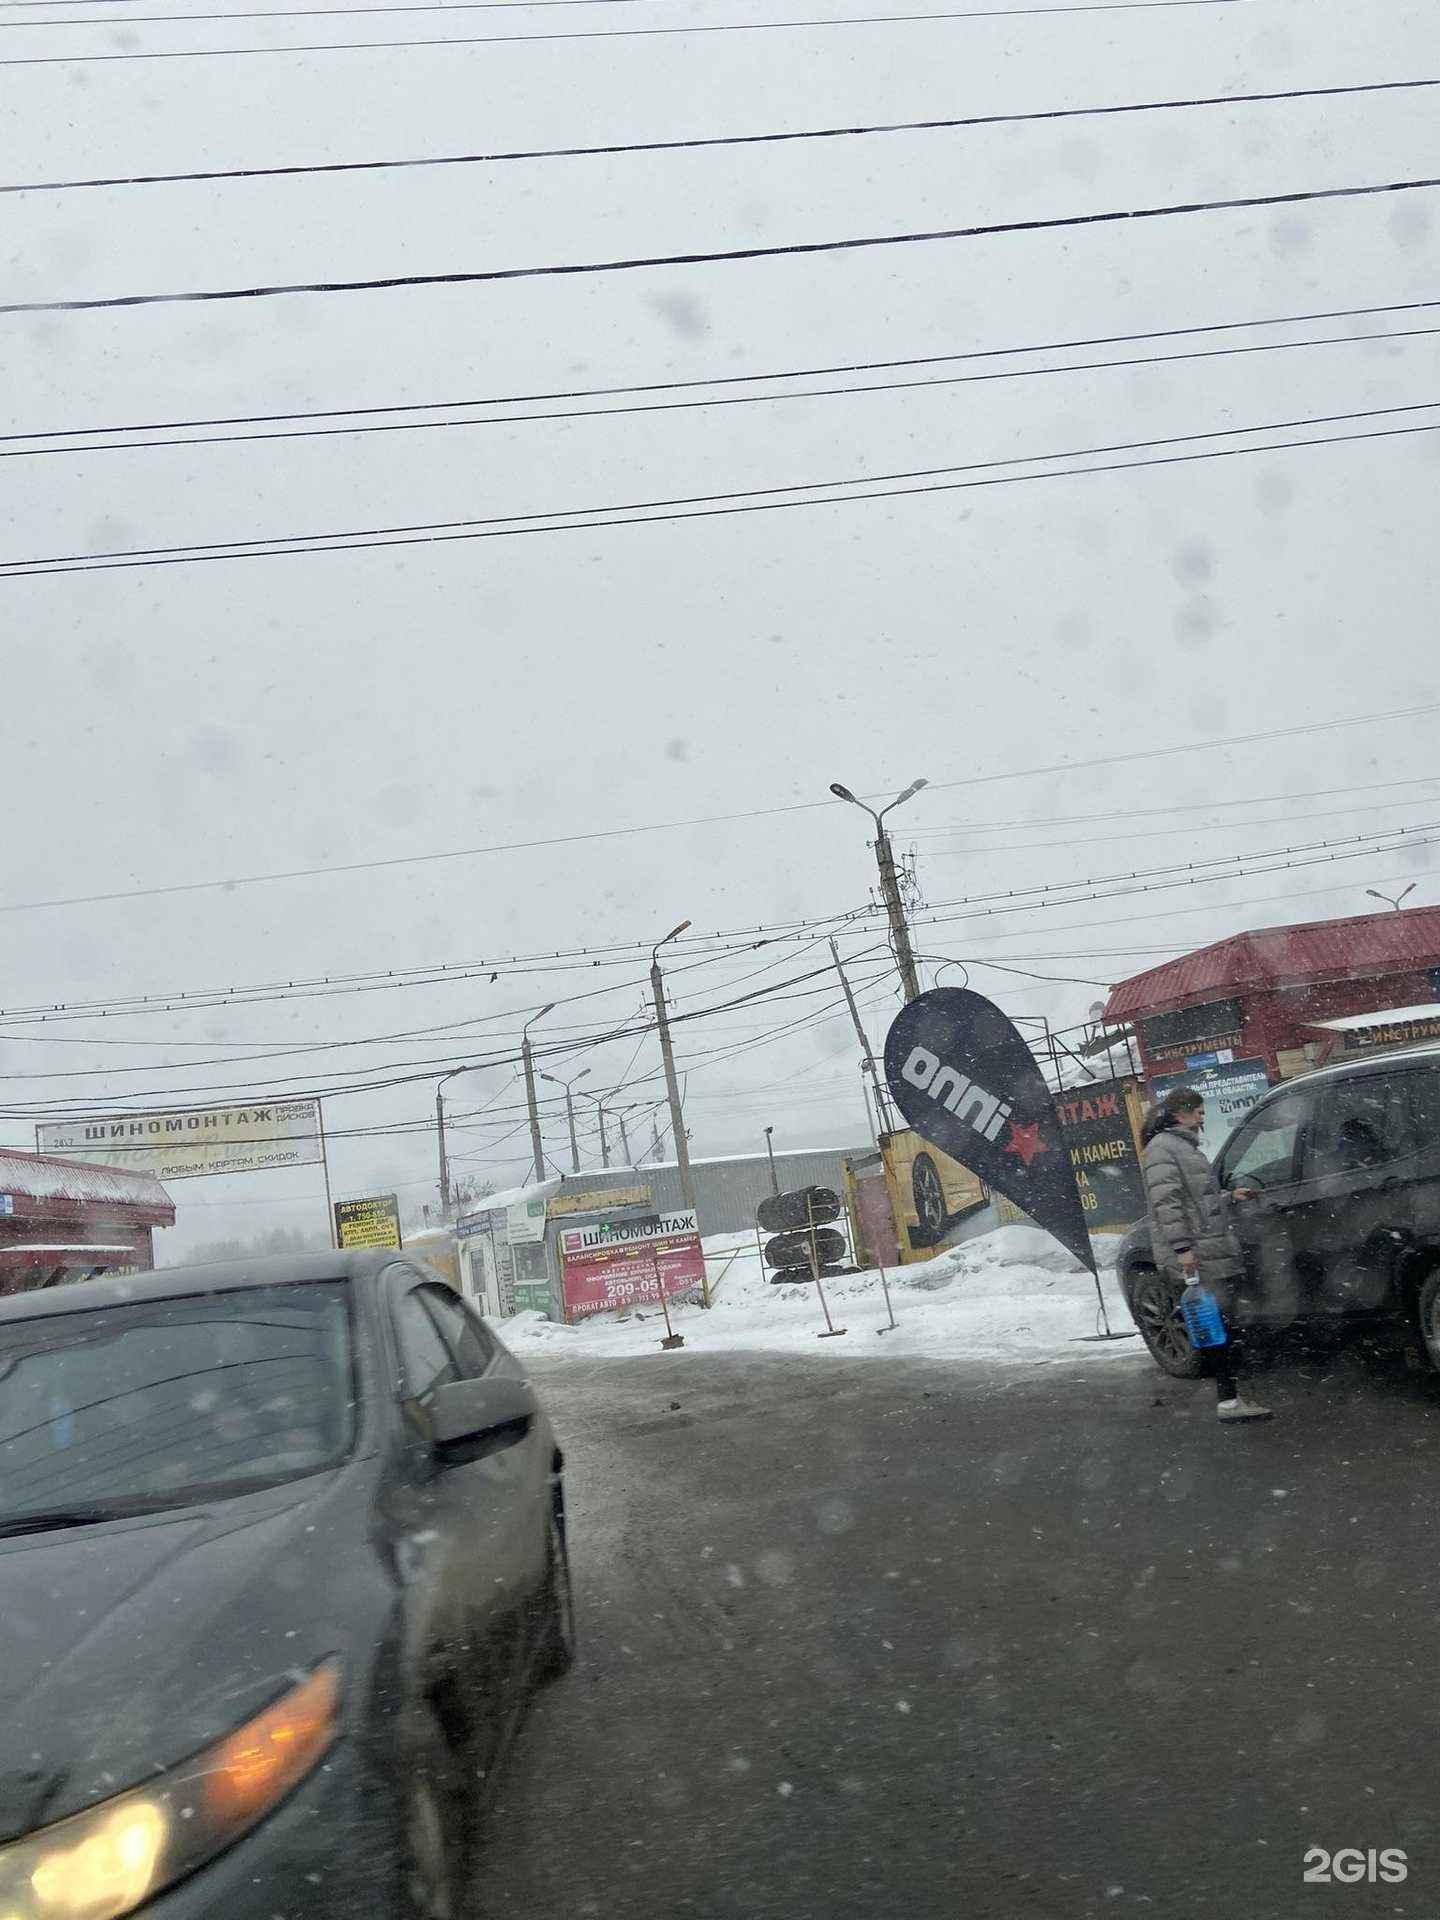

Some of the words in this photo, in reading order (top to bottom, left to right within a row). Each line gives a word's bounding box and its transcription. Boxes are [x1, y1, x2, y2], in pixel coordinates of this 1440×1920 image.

[901, 1046, 1012, 1142] onni
[85, 1109, 272, 1139] ШИНОМОНТАЖ
[161, 1163, 205, 1175] ЛЮБЫМ
[258, 1151, 300, 1165] СКИДОК
[1070, 1148, 1081, 1165] И
[1082, 1140, 1126, 1163] КАМЕР
[583, 1216, 695, 1247] ШИНОМОНТАЖ
